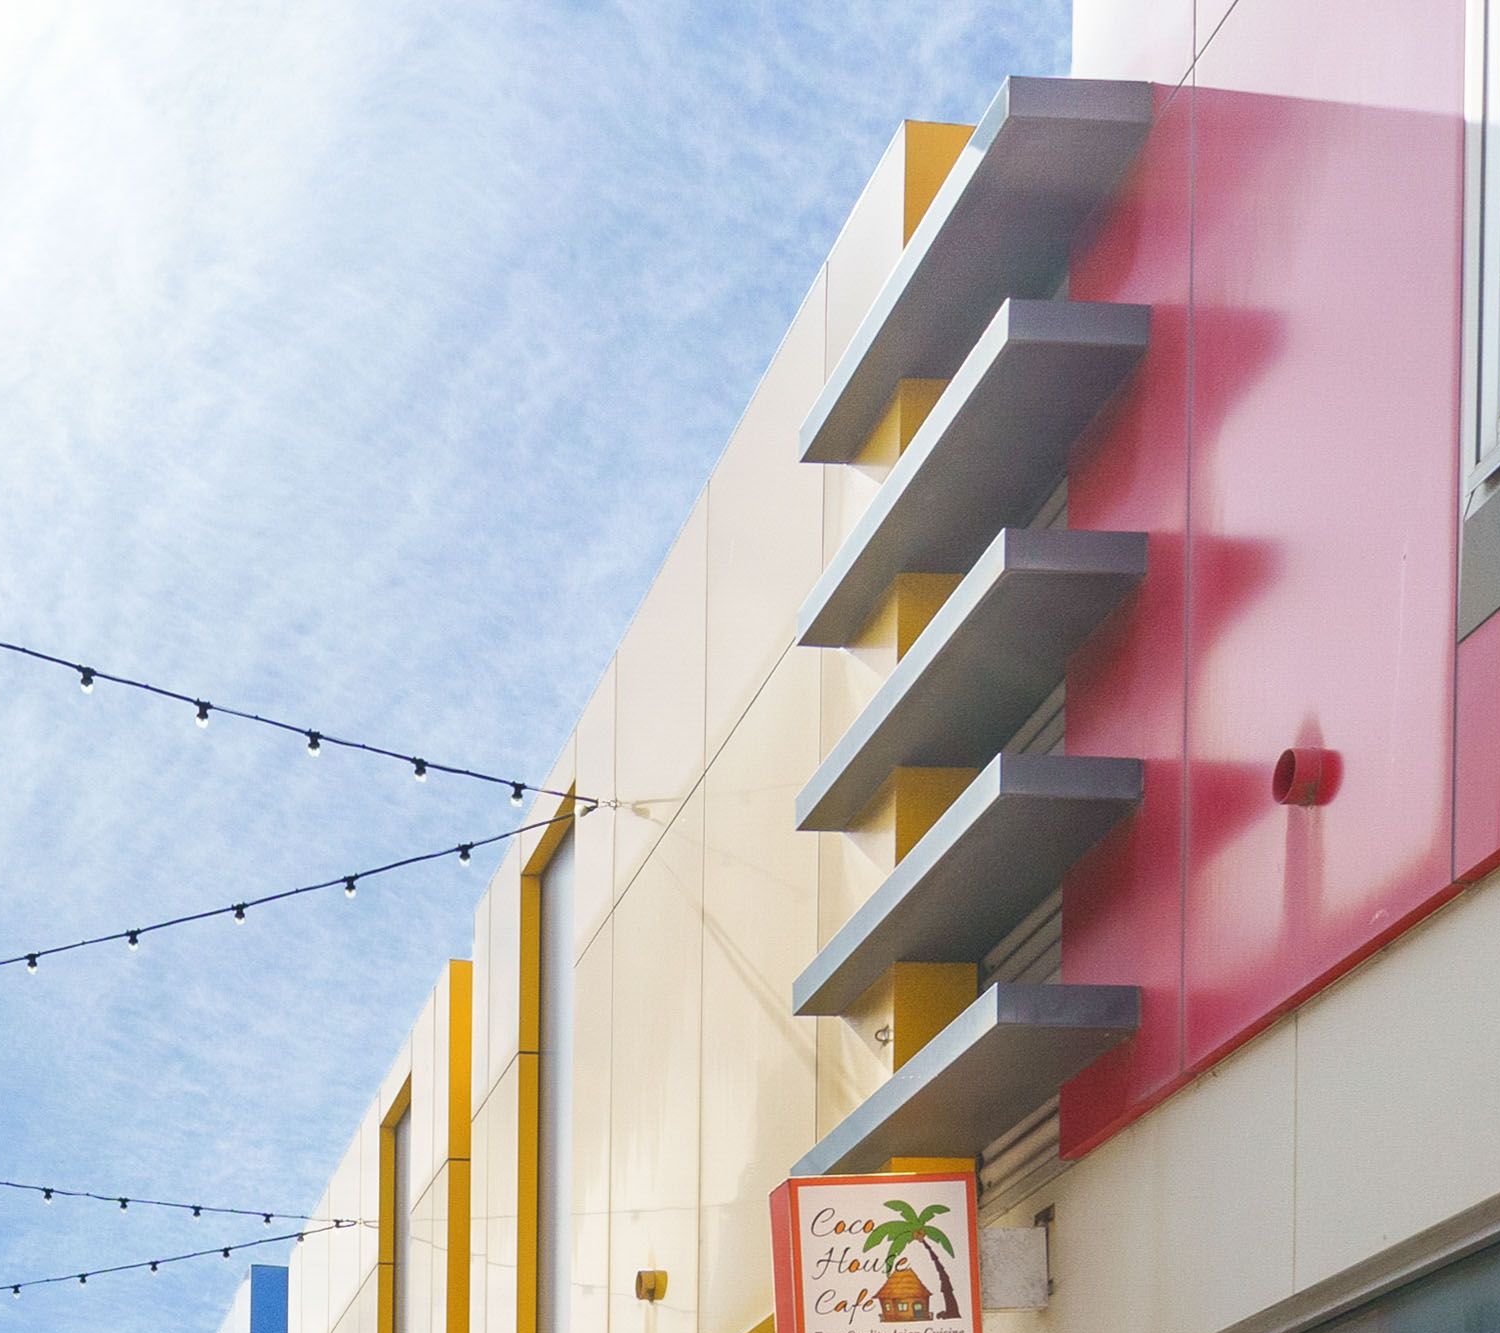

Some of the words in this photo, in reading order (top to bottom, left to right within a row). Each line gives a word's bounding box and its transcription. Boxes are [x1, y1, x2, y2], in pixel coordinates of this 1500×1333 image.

[810, 1207, 876, 1238] Coco
[811, 1246, 911, 1280] House
[814, 1288, 875, 1325] Cafe
